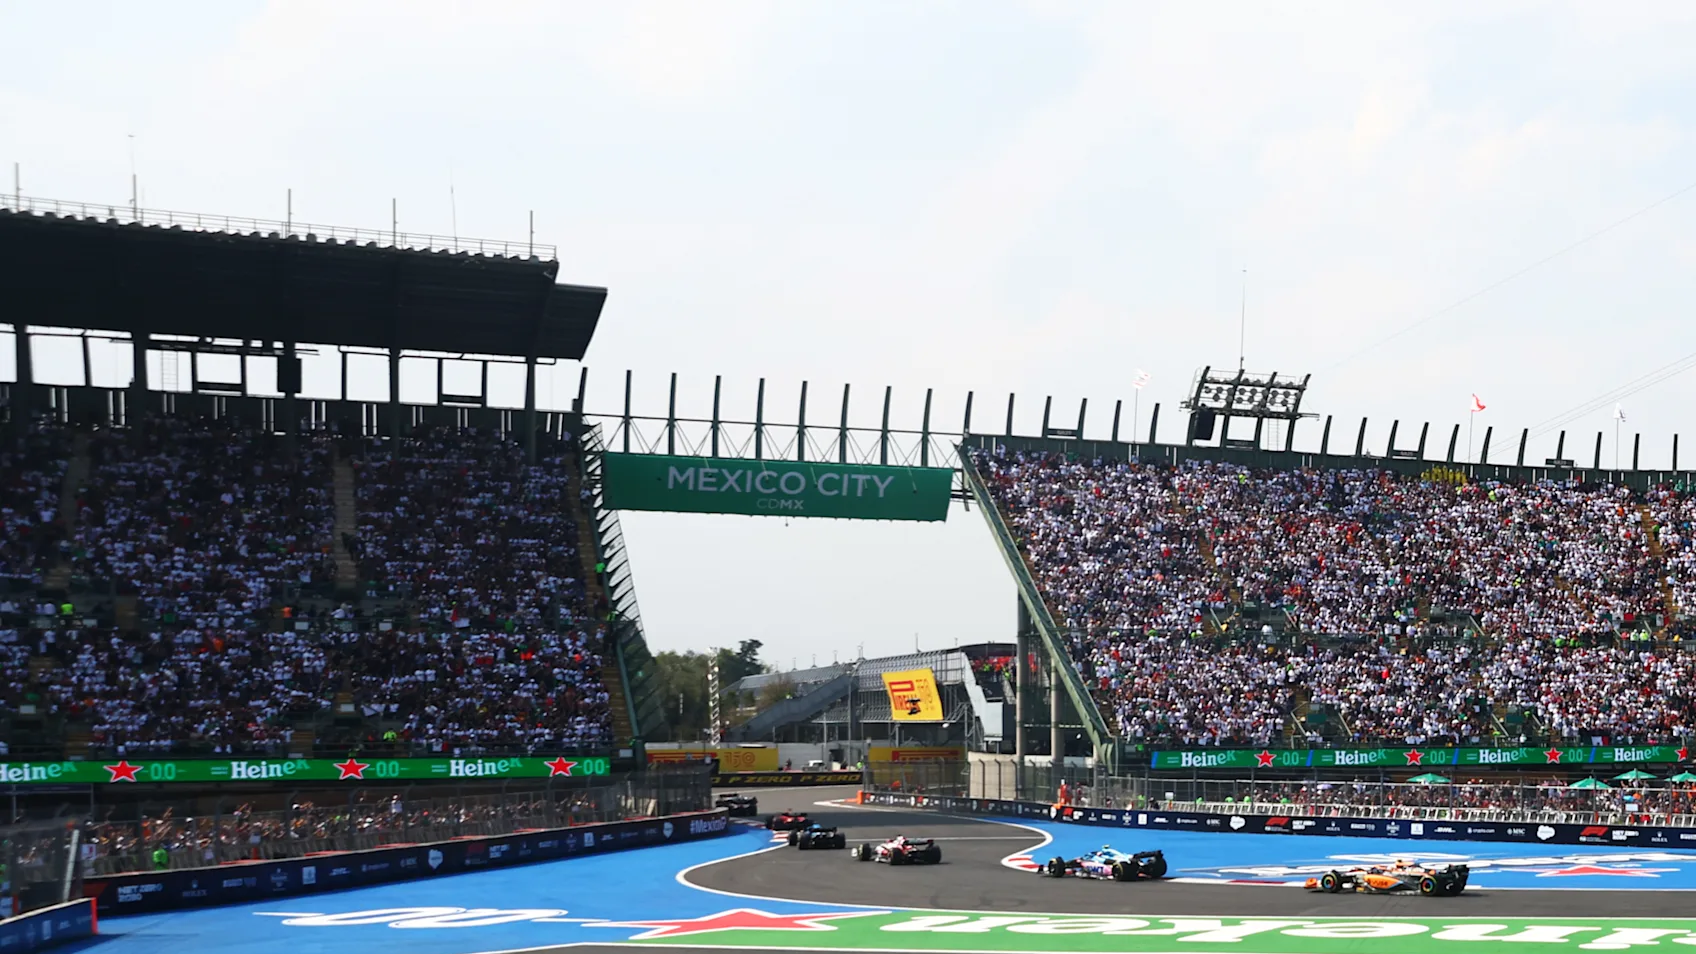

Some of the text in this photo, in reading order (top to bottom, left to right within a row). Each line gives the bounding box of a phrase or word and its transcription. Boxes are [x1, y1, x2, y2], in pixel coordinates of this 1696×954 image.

[667, 466, 895, 498] MEXICO CITY
[757, 498, 804, 510] CDMX
